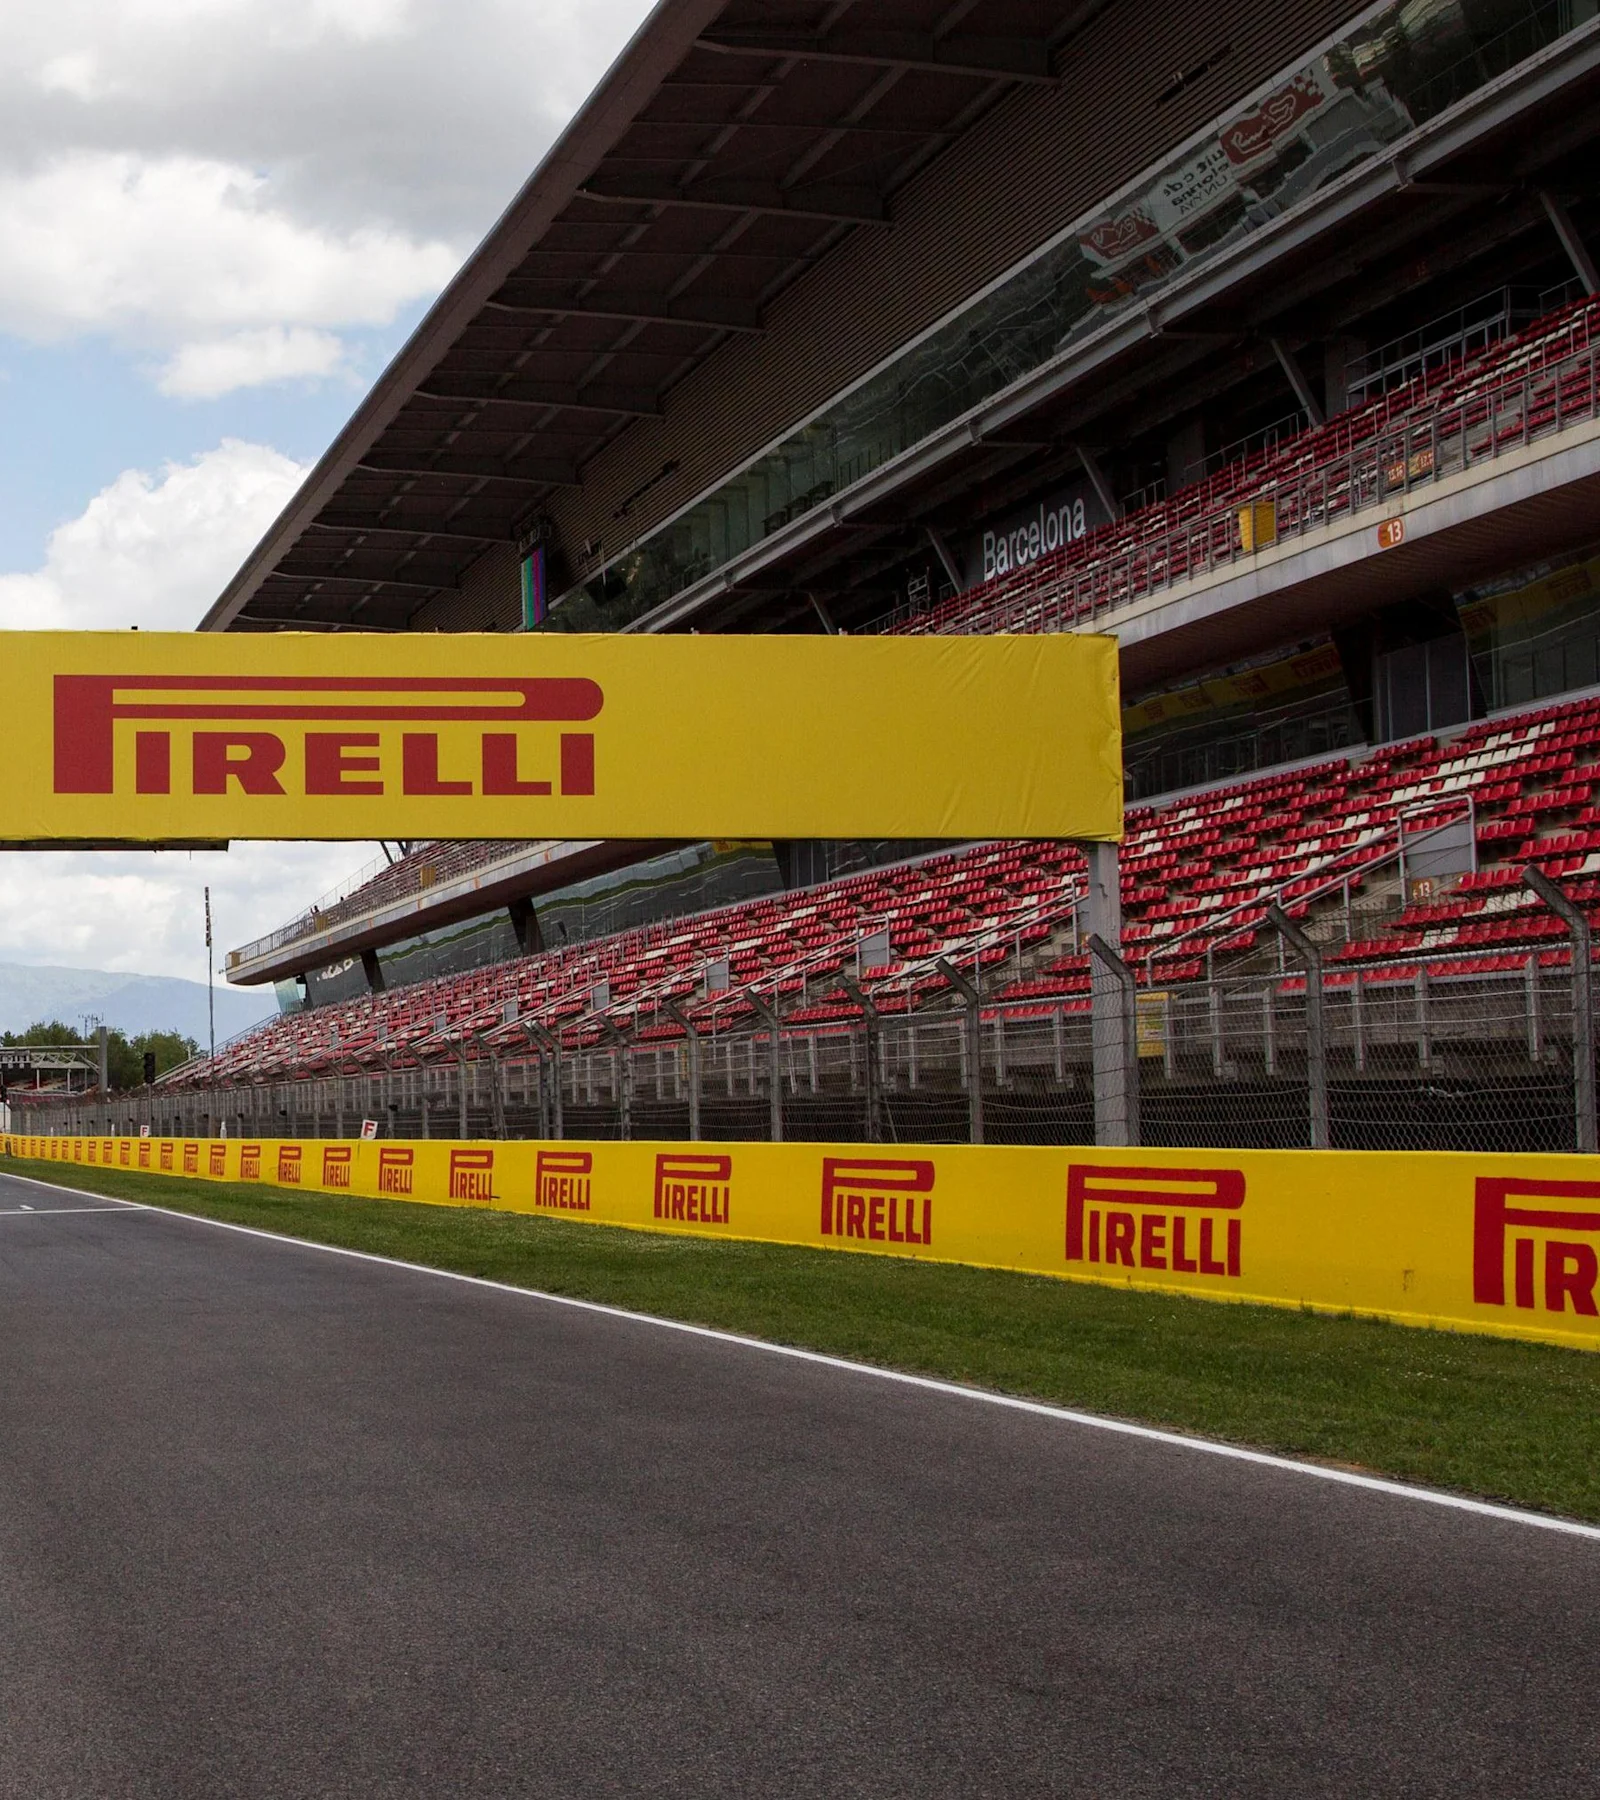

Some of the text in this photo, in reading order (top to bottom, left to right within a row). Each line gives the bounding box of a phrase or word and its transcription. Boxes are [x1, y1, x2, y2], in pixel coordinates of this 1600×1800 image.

[983, 498, 1087, 581] Barcelona
[1387, 521, 1402, 542] 13
[54, 675, 603, 796] PIRELLI
[1418, 881, 1431, 897] 13
[363, 1121, 375, 1136] F
[278, 1146, 302, 1183] PIRELLI
[324, 1147, 351, 1189] PIRELLI
[379, 1149, 413, 1192] PIRELLI
[450, 1150, 493, 1200] PIRELLI
[536, 1152, 592, 1209] PIRELLI
[655, 1155, 731, 1222] PIRELLI
[822, 1158, 934, 1245] PIRELLI
[1066, 1165, 1246, 1277] PIRELLI
